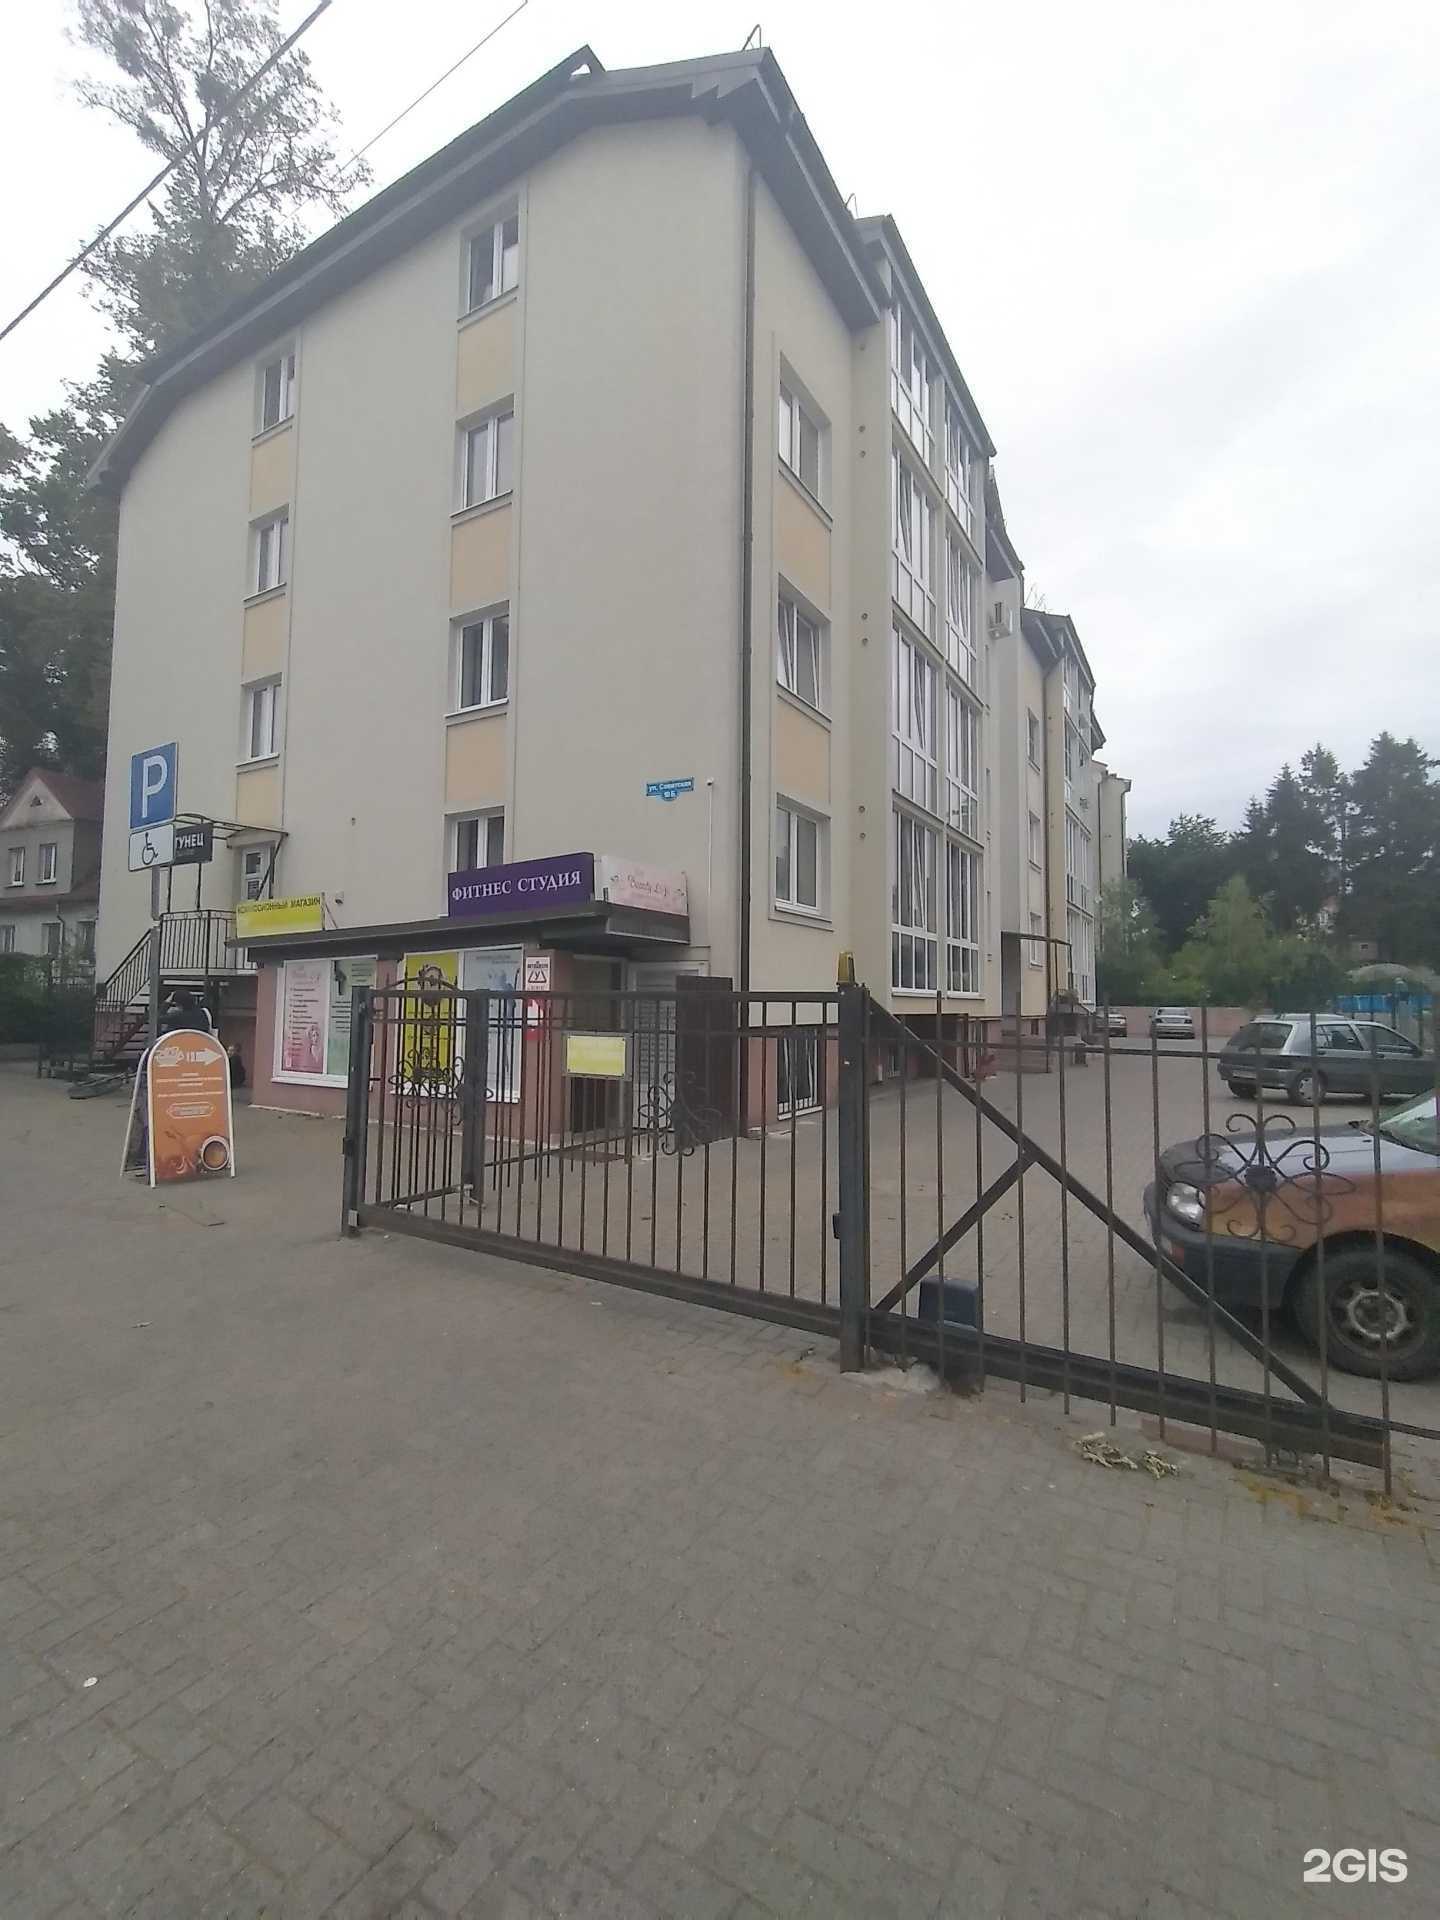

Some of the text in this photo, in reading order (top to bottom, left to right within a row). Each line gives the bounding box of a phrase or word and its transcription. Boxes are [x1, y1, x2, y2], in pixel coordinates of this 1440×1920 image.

[452, 870, 582, 901] ФИТНЕС СТУДИЯ
[290, 896, 321, 909] МАГАЗИН
